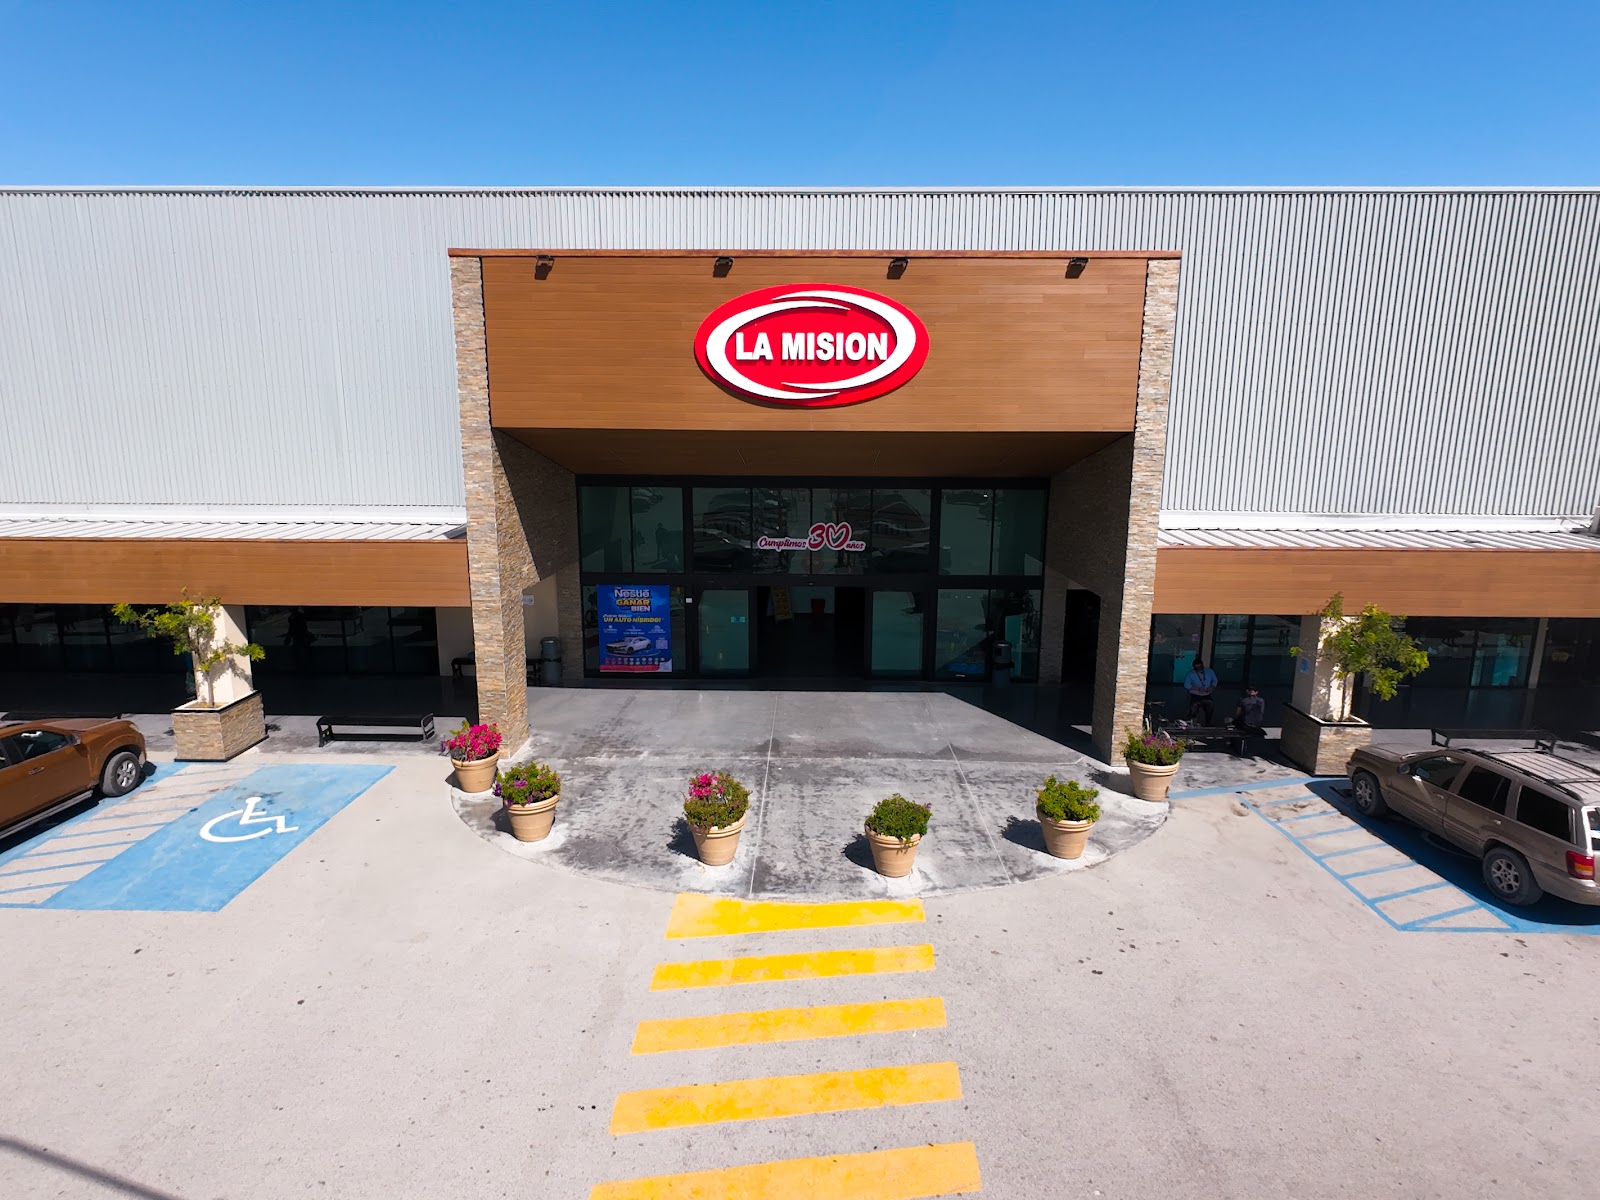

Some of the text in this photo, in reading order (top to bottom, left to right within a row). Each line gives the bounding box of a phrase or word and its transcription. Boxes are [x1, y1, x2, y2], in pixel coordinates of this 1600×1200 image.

[736, 332, 888, 361] LA MISION
[758, 537, 807, 550] Cumplimos
[808, 523, 851, 550] 30
[614, 588, 650, 598] Nestlé
